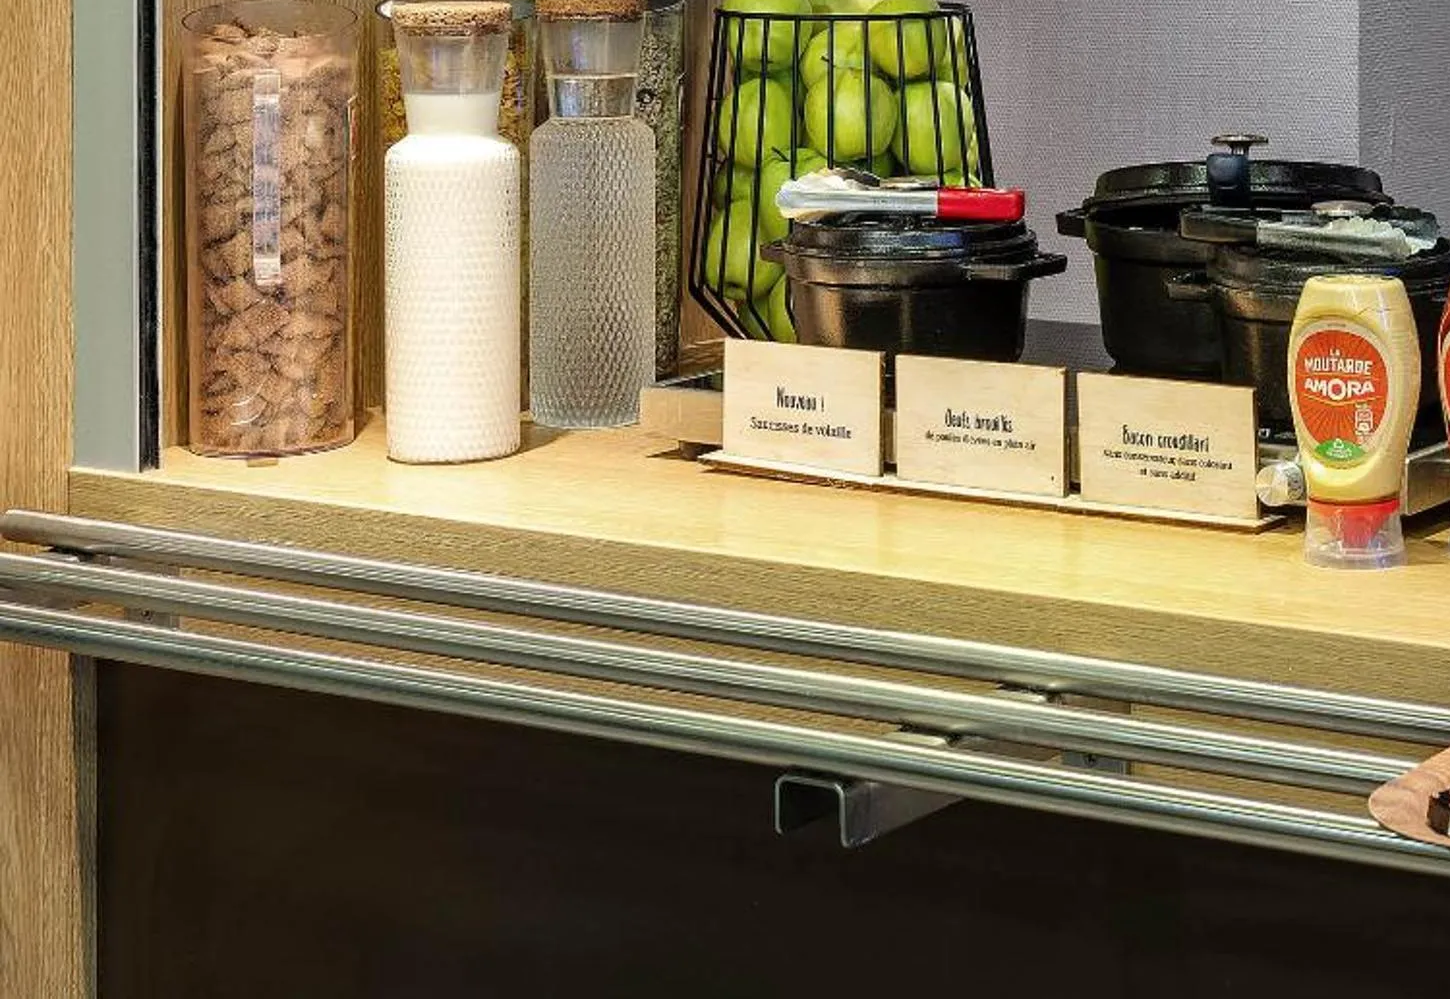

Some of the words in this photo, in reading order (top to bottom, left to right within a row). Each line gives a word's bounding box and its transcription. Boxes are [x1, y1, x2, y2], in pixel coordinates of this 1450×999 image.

[1304, 357, 1374, 376] MOUTARDE
[1304, 377, 1376, 401] AMORA
[802, 423, 813, 435] de
[815, 424, 852, 439] volaille
